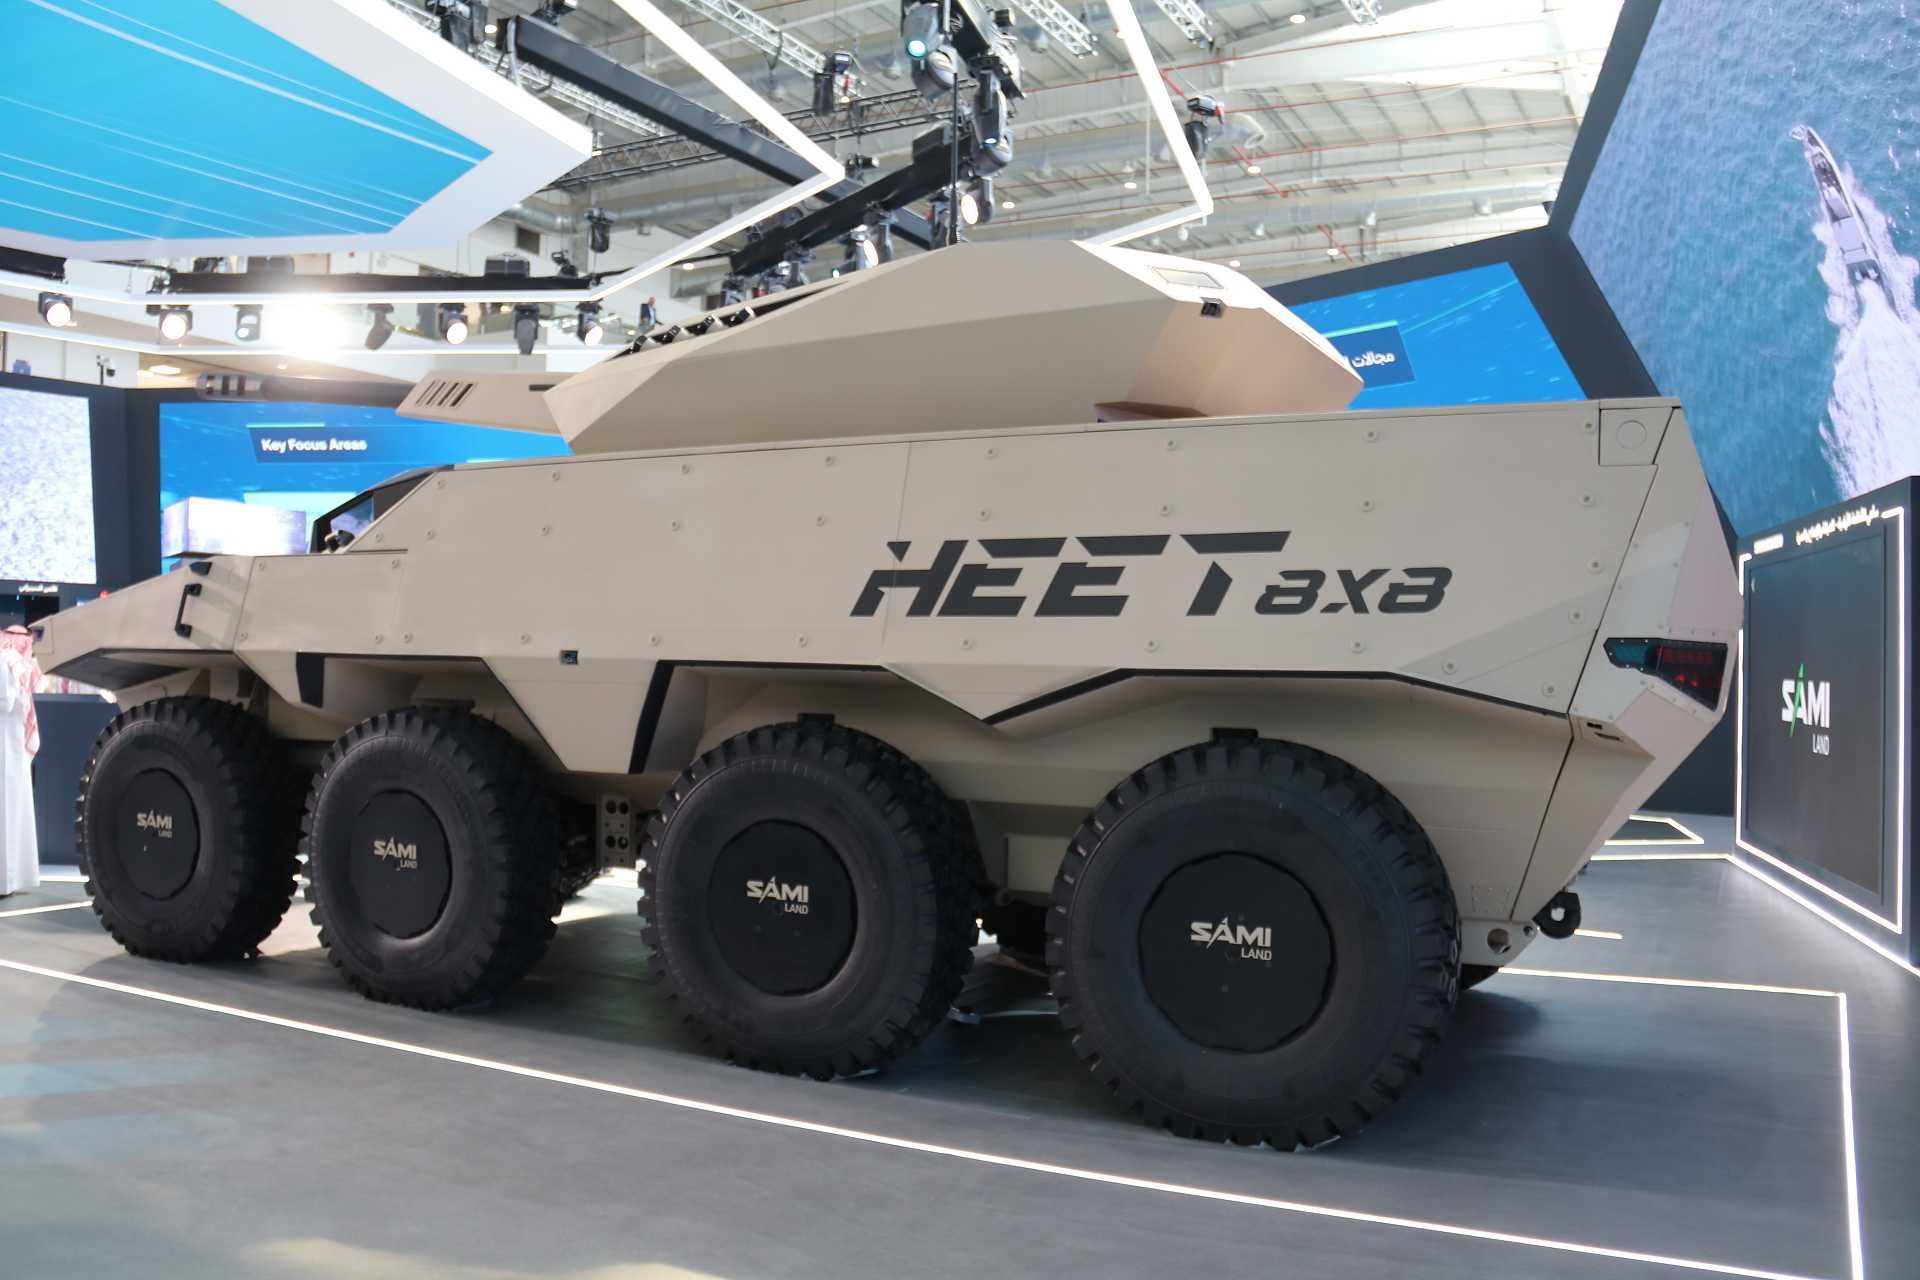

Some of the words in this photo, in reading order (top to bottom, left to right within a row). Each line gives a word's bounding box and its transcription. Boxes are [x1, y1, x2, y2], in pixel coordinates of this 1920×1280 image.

[262, 439, 286, 453] Key
[288, 439, 327, 450] Focus
[328, 439, 367, 450] Areas
[850, 531, 1291, 617] HEET
[1782, 664, 1830, 737] SAMI
[137, 810, 172, 831] SAMI
[374, 837, 416, 861] SAMI
[746, 876, 809, 903] SAMI
[785, 903, 808, 915] LAND
[1191, 917, 1271, 948] SAMI
[1241, 947, 1272, 960] LAND
